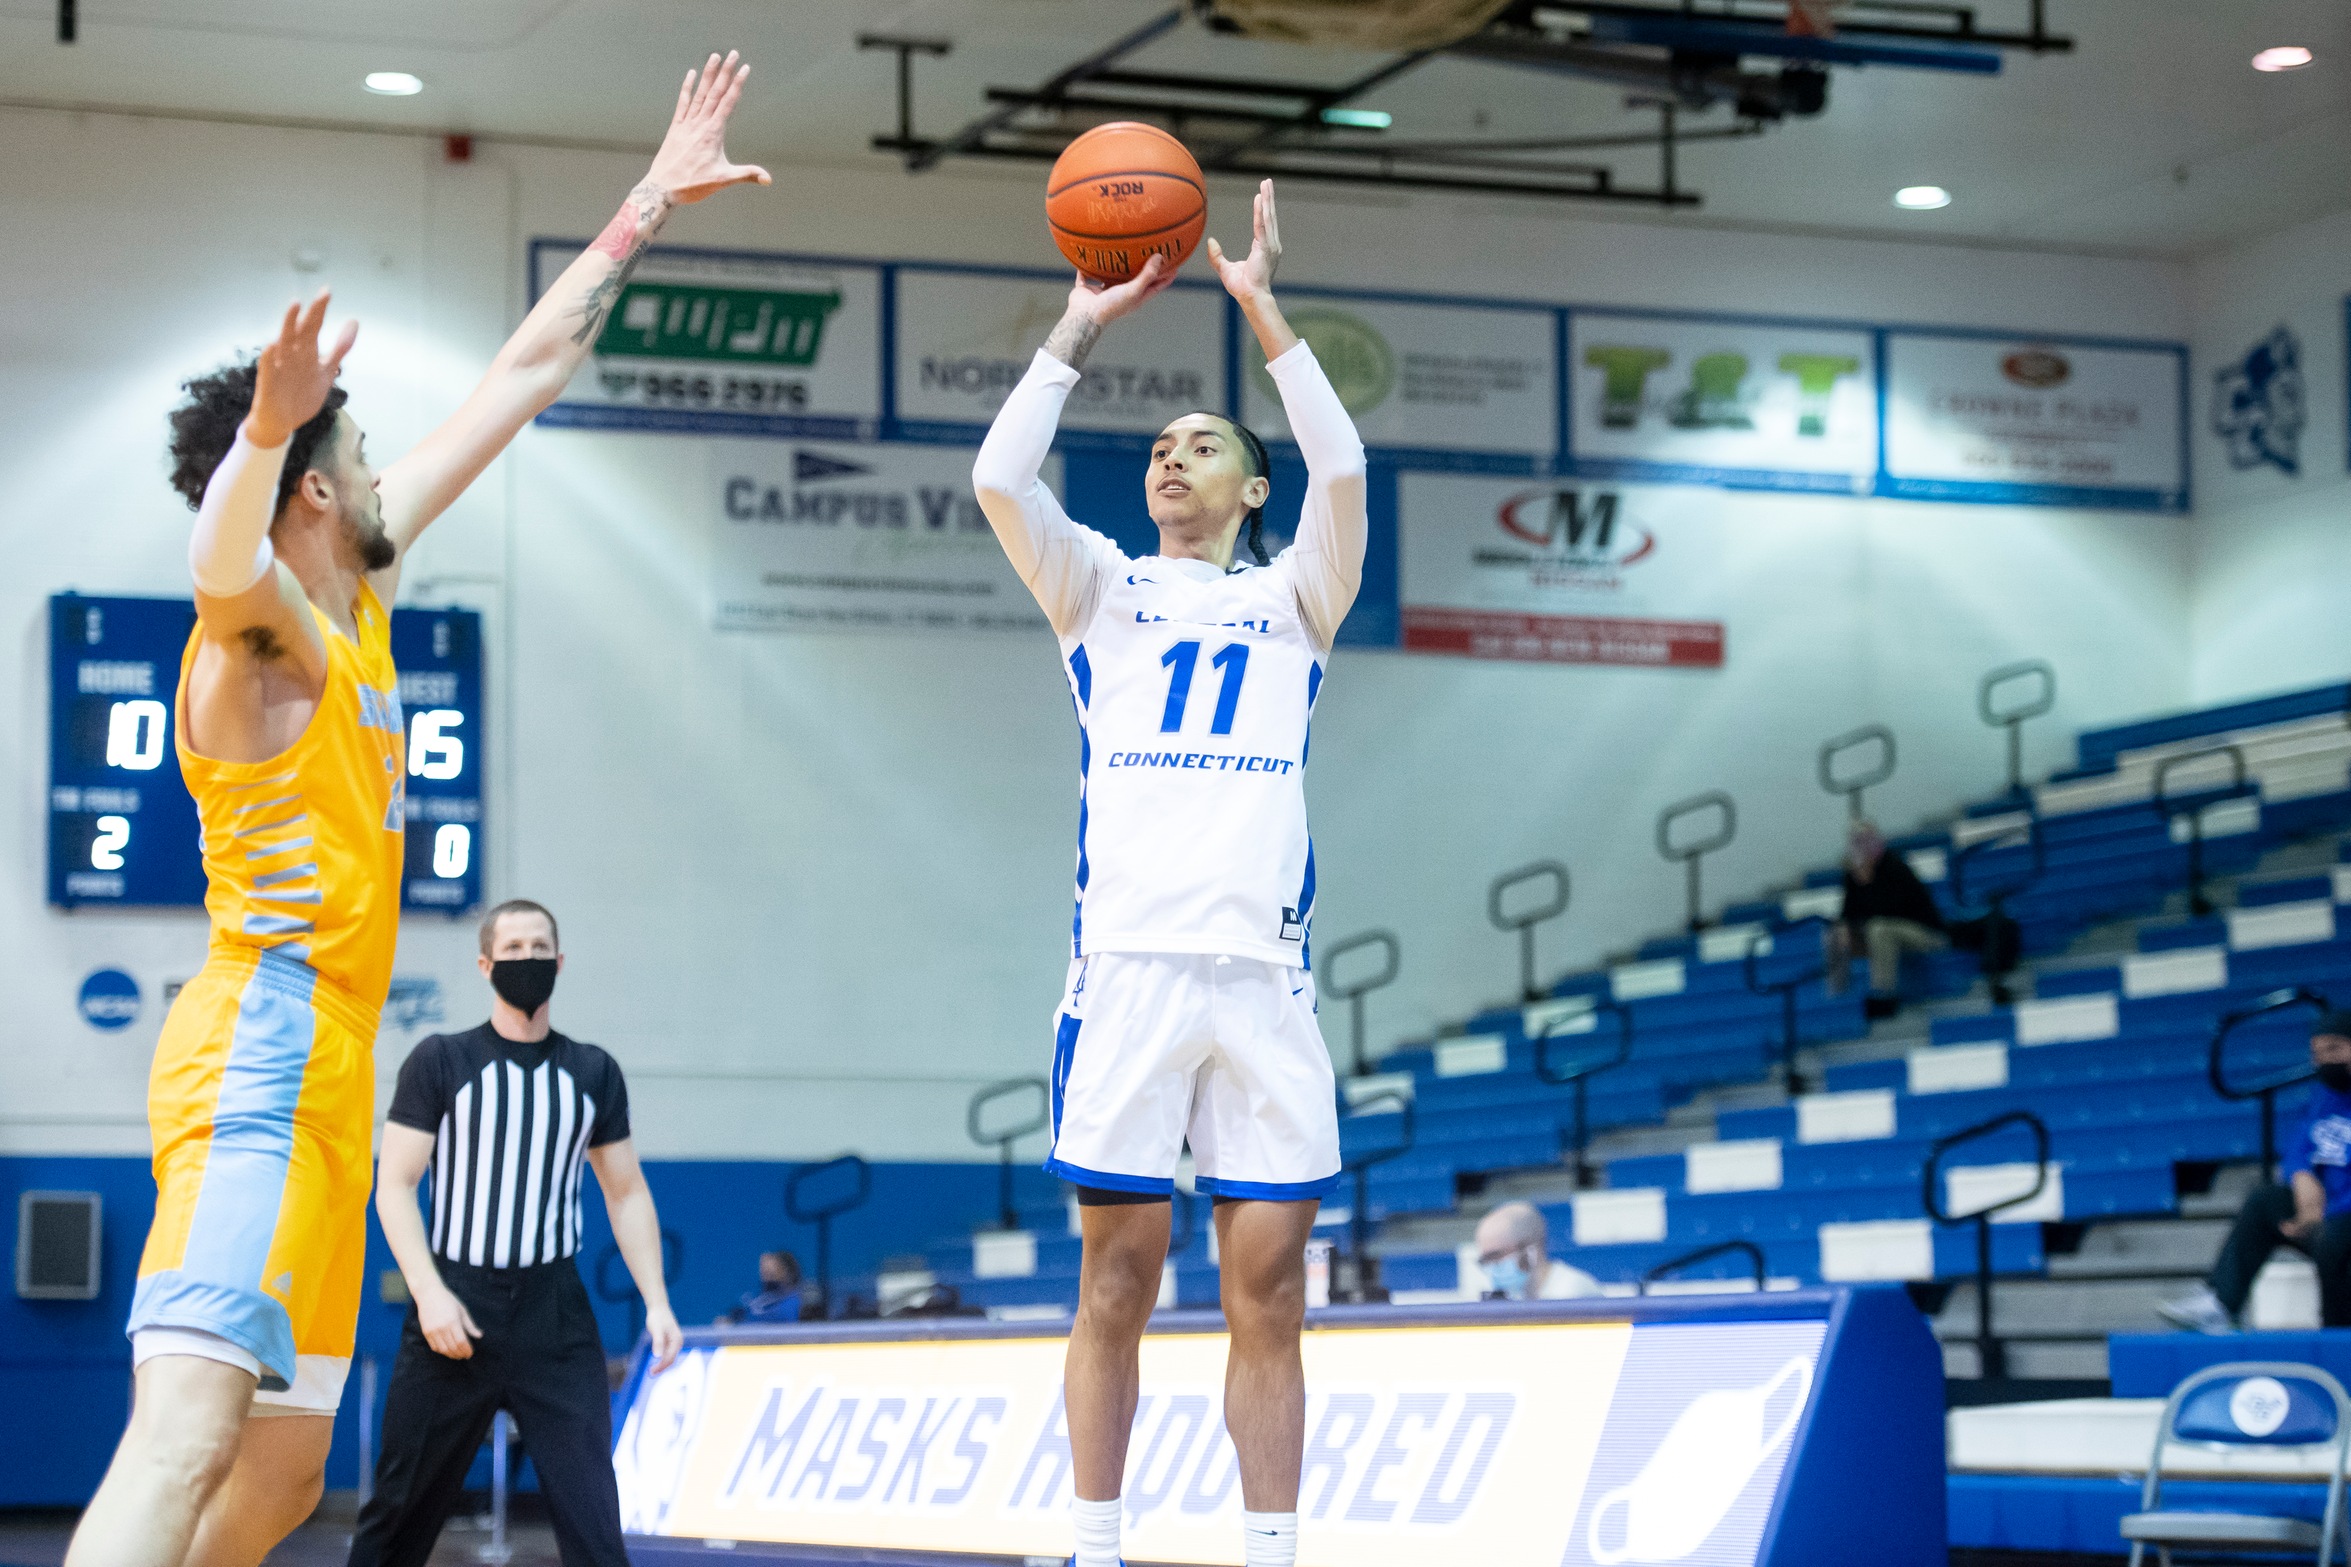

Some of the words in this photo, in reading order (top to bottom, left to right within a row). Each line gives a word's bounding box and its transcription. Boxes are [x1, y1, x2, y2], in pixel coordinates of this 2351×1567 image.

[1100, 181, 1144, 196] ROCK
[725, 476, 909, 528] CAMPUS
[77, 660, 155, 695] HOME
[396, 670, 458, 706] UEST
[1158, 637, 1252, 739] 11
[106, 700, 167, 770] 10
[408, 709, 465, 779] 15
[1107, 752, 1295, 776] CONNECTICUT
[91, 815, 130, 870] 2
[433, 824, 471, 878] 0
[725, 1385, 1008, 1505] MASKS
[1007, 1382, 1517, 1530] RQURED
